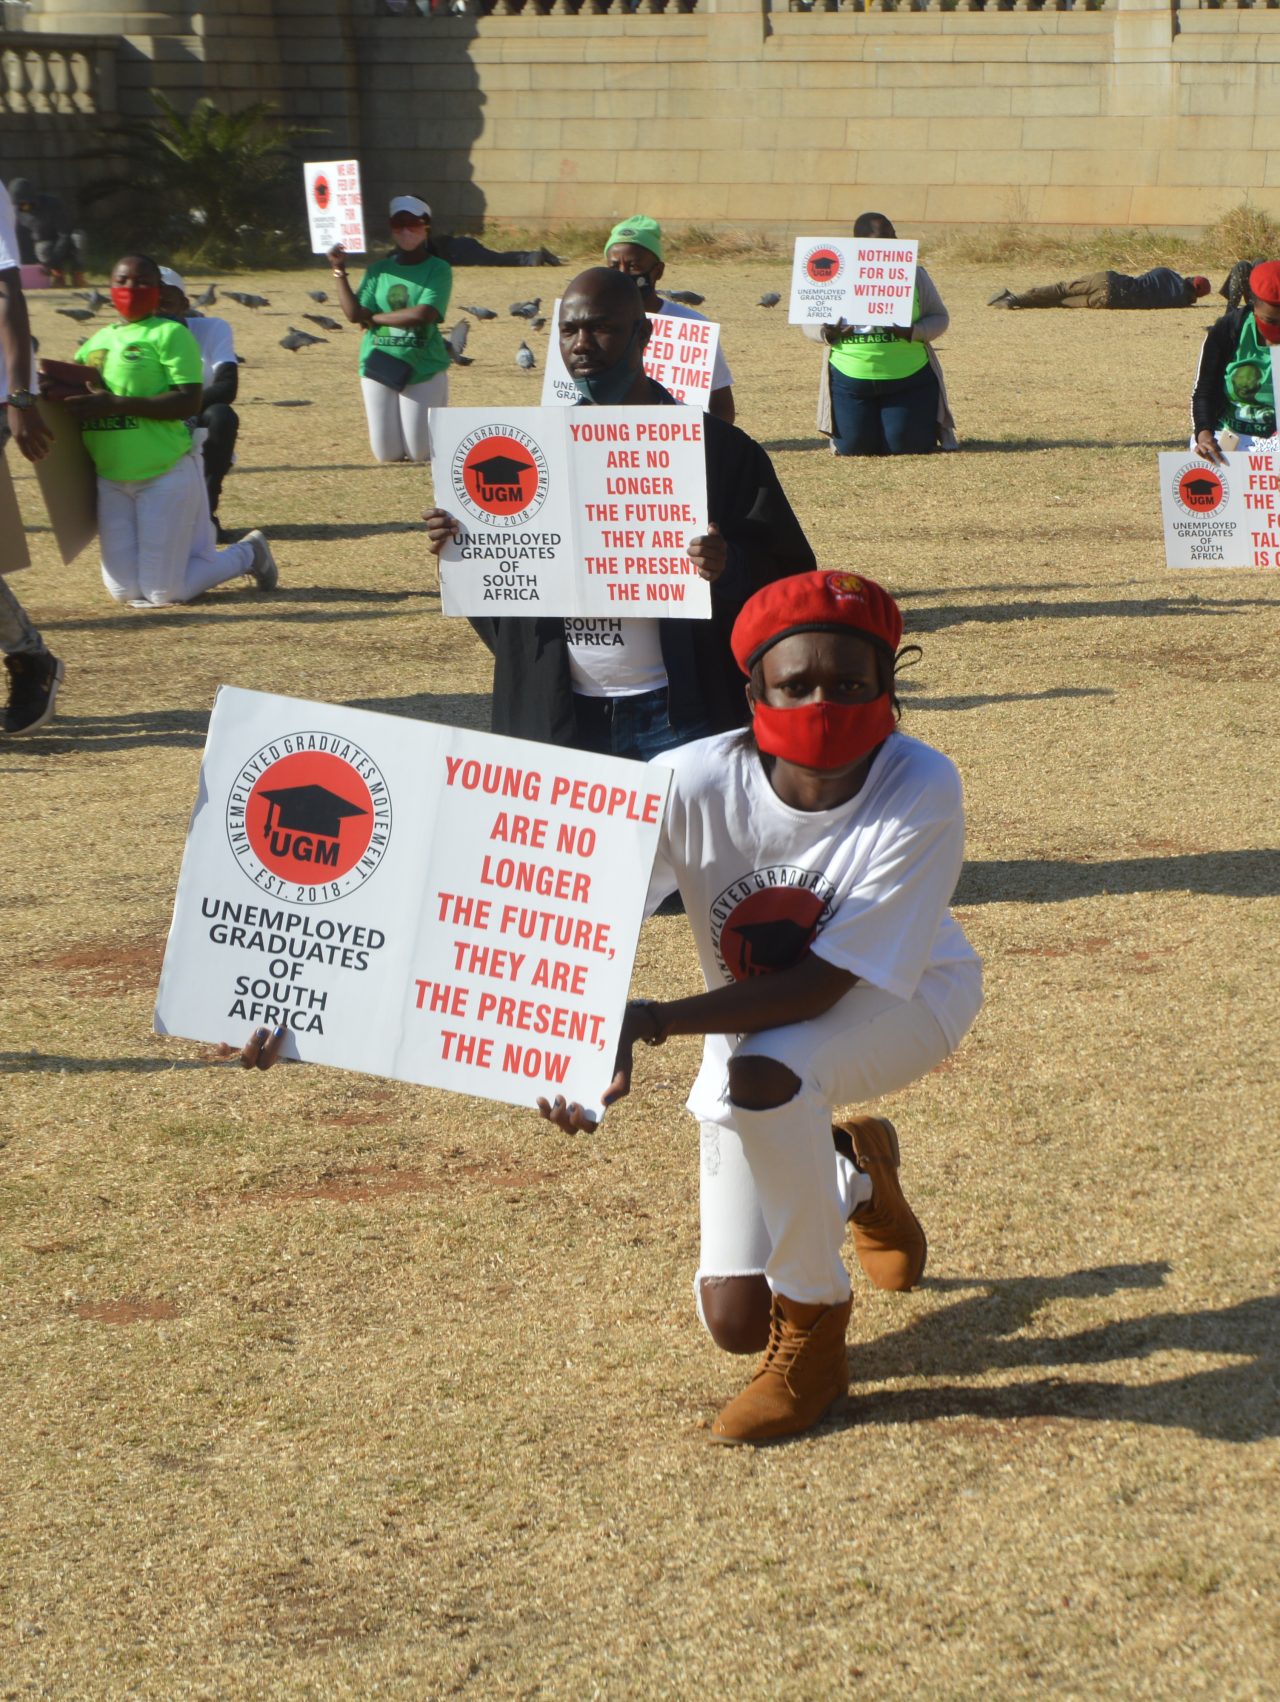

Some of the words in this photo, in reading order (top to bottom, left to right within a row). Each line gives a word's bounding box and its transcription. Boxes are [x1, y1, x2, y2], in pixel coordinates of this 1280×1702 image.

[858, 250, 912, 263] NOTHING
[860, 268, 885, 280] FOR
[889, 268, 908, 282] US,
[854, 285, 911, 297] WITHOUT
[868, 303, 894, 315] US!!
[652, 319, 673, 338] WE
[678, 323, 711, 344] ARE
[680, 346, 708, 366] UP!
[645, 362, 664, 382] HE
[671, 366, 711, 389] TIME
[570, 423, 630, 442] YOUNG
[636, 423, 701, 442] PEOPLE
[454, 438, 474, 506] UNEMPLOYED
[474, 426, 531, 448] GRADUATES
[531, 447, 547, 505] MOVEMENT
[607, 451, 640, 468] ARE
[646, 450, 670, 468] NO
[1248, 456, 1273, 471] WE
[607, 477, 674, 495] LONGER
[1249, 475, 1280, 490] FED
[482, 487, 523, 502] UGM
[1189, 497, 1214, 505] UGM
[1244, 494, 1274, 509] THE
[504, 510, 529, 525] 2018
[585, 504, 618, 522] THE
[625, 504, 697, 525] FUTURE,
[454, 533, 561, 546] UNEMPLOYED
[601, 530, 645, 548] THEY
[652, 530, 684, 548] ARE
[461, 547, 555, 560] GRADUATES
[1254, 552, 1269, 567] IS
[499, 561, 519, 573] OF
[585, 557, 618, 574] THE
[483, 575, 537, 587] SOUTH
[483, 588, 540, 600] AFRICA
[607, 583, 640, 601] THE
[646, 583, 685, 601] NOW
[565, 618, 622, 631] SOUTH
[565, 632, 624, 646] AFRICA
[445, 756, 542, 802] YOUNG
[550, 776, 661, 824] PEOPLE
[229, 745, 280, 855] UNEMPLOYED
[284, 735, 377, 780] GRADUATES
[360, 782, 389, 881] MOVEMENT
[489, 812, 548, 849] ARE
[556, 823, 597, 858] NO
[269, 831, 340, 867] UGM
[480, 855, 591, 904] LONGER
[297, 882, 341, 902] 2018
[201, 897, 385, 950] UNEMPLOYED
[437, 892, 492, 930] THE
[500, 905, 616, 961] FUTURE,
[208, 924, 370, 972] GRADUATES
[269, 958, 305, 982] OF
[453, 941, 526, 982] THEY
[531, 962, 588, 996] ARE
[234, 975, 328, 1012] SOUTH
[228, 999, 325, 1035] AFRICA
[414, 979, 469, 1017] THE
[477, 992, 606, 1051] PRESENT,
[440, 1030, 494, 1068] THE
[502, 1043, 571, 1084] NOW
